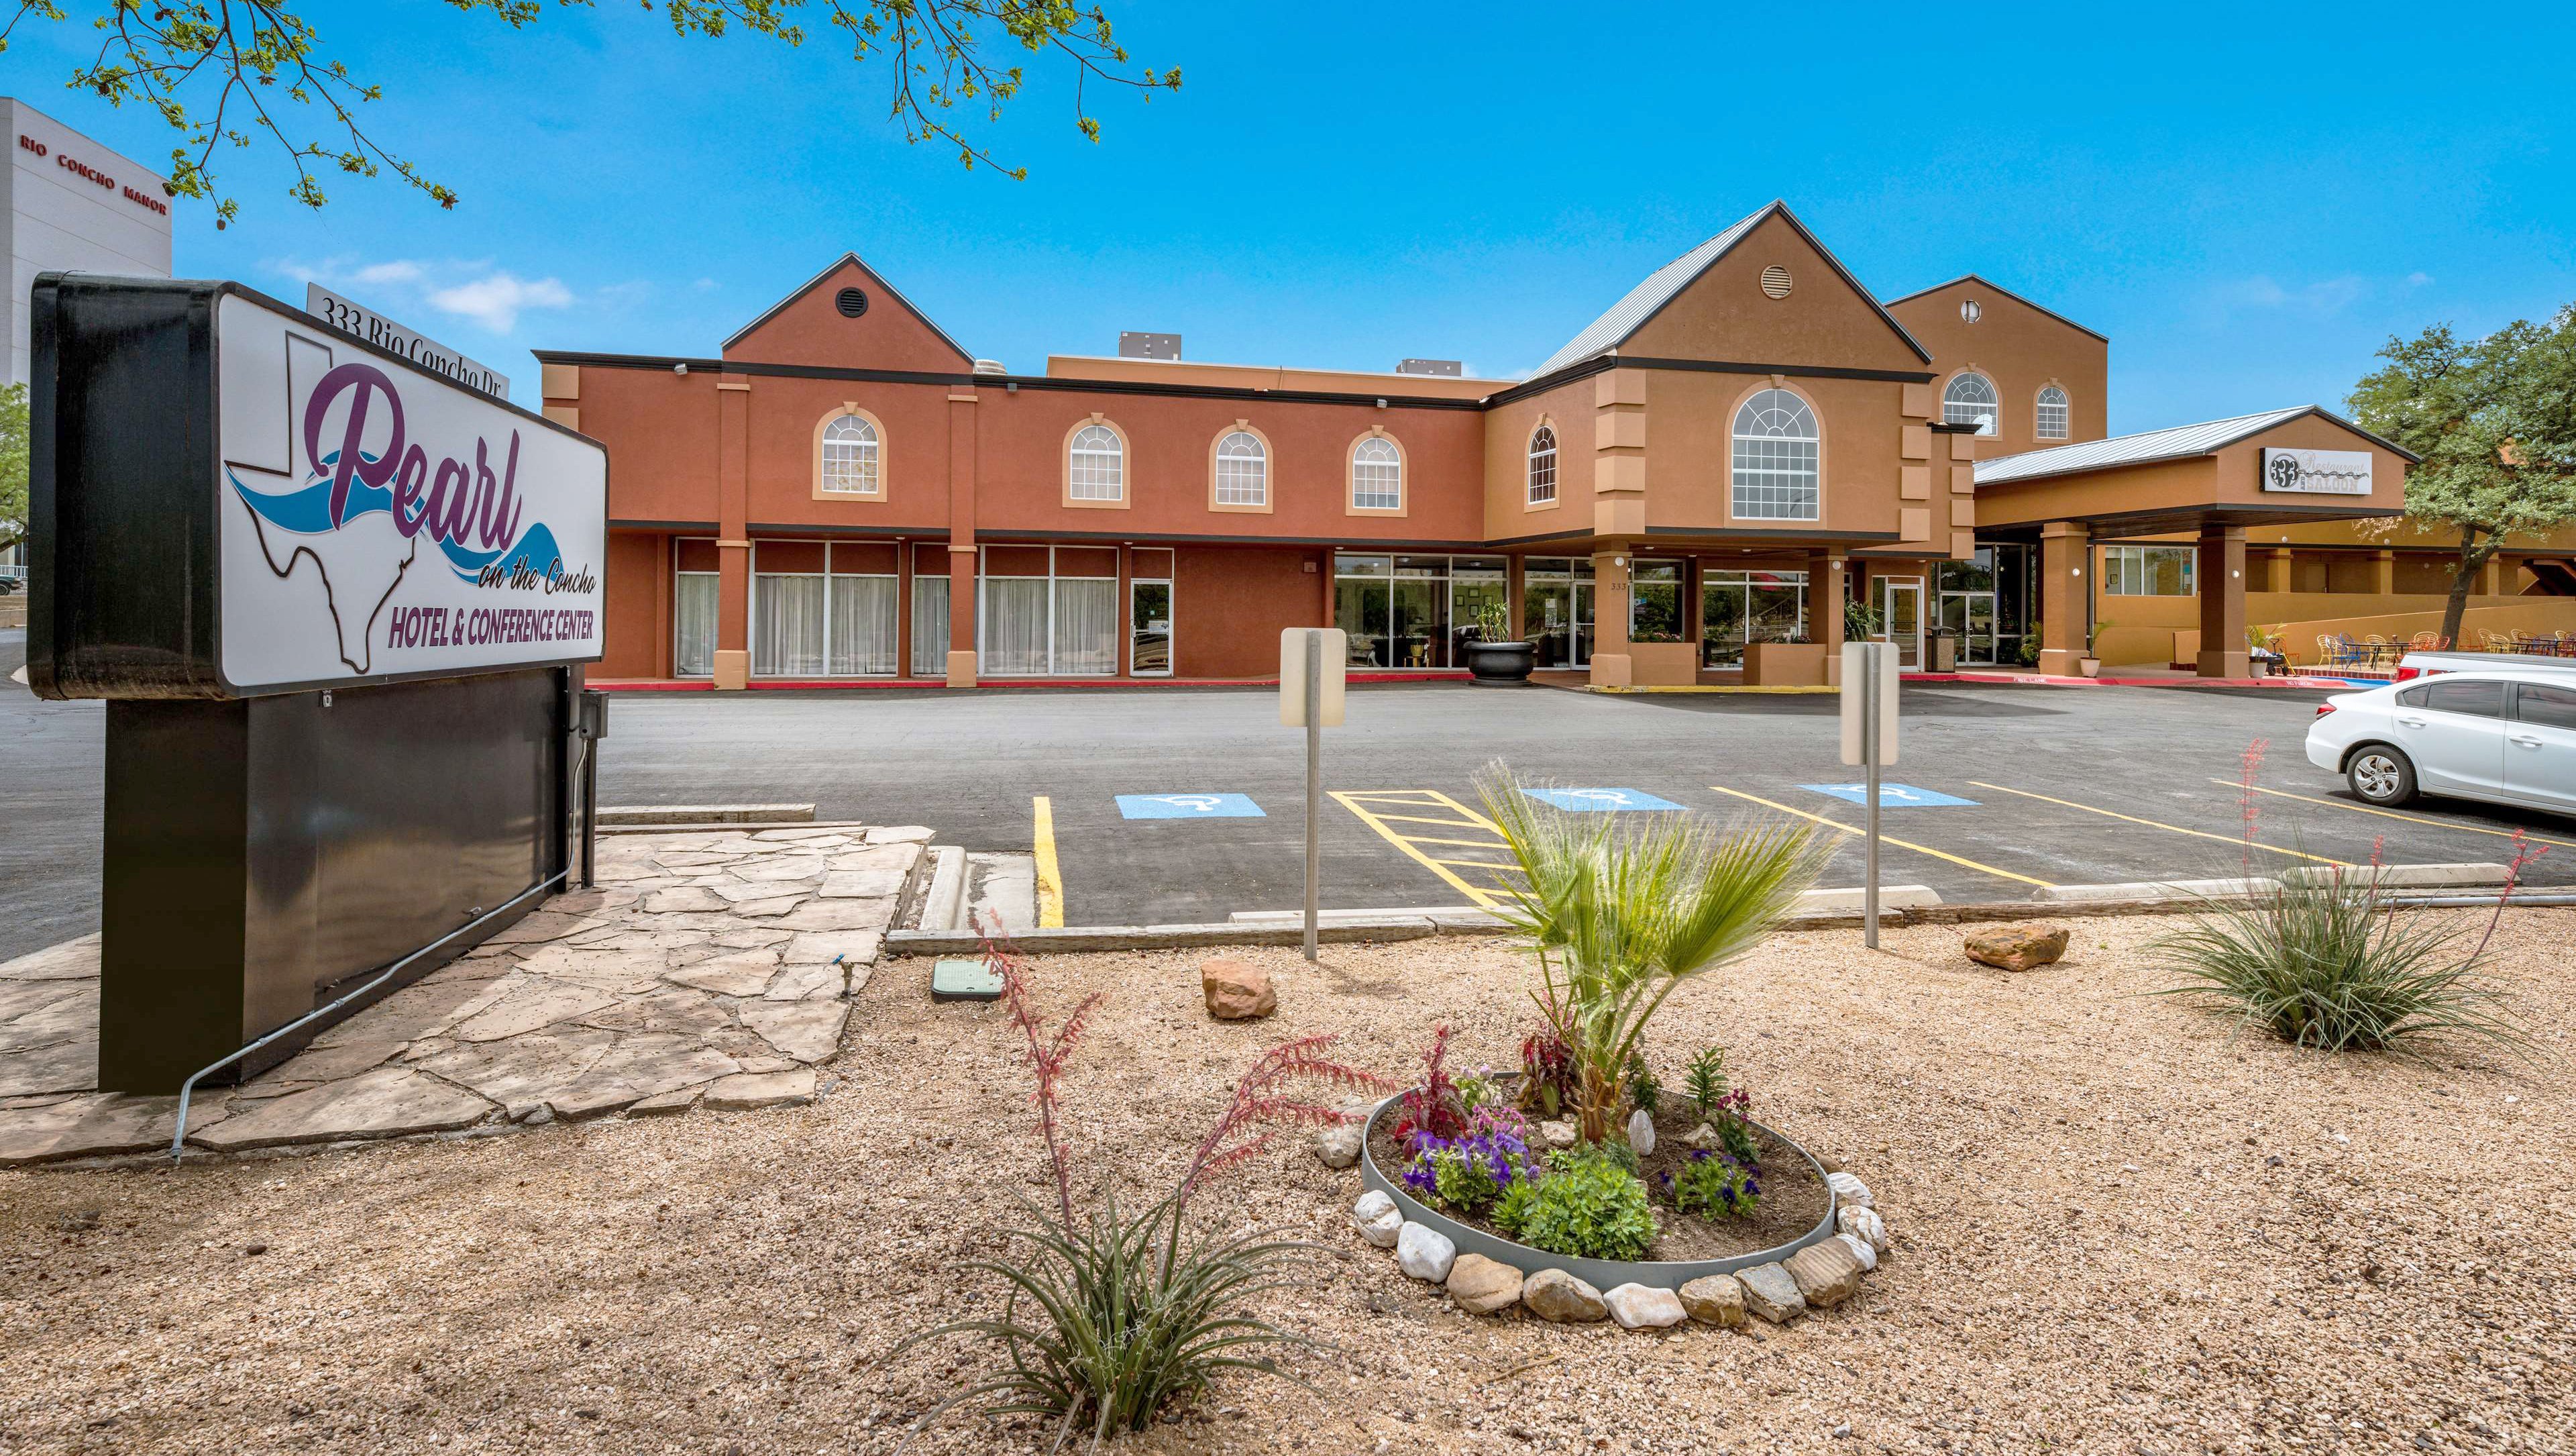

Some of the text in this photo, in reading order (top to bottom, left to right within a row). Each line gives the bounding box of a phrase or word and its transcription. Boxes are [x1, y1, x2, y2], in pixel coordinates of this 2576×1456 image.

[21, 135, 167, 215] RIO CONCHO MANOR
[323, 297, 501, 397] 333 Rio Concho Dr
[304, 363, 521, 552] Pearl
[2271, 459, 2299, 488] 333
[2298, 451, 2365, 472] Restaurant
[2306, 478, 2358, 492] SALOON
[478, 554, 596, 595] on the Concho
[1611, 582, 1627, 590] 333
[388, 607, 594, 648] HOTEL & CONFERENCE CENTER
